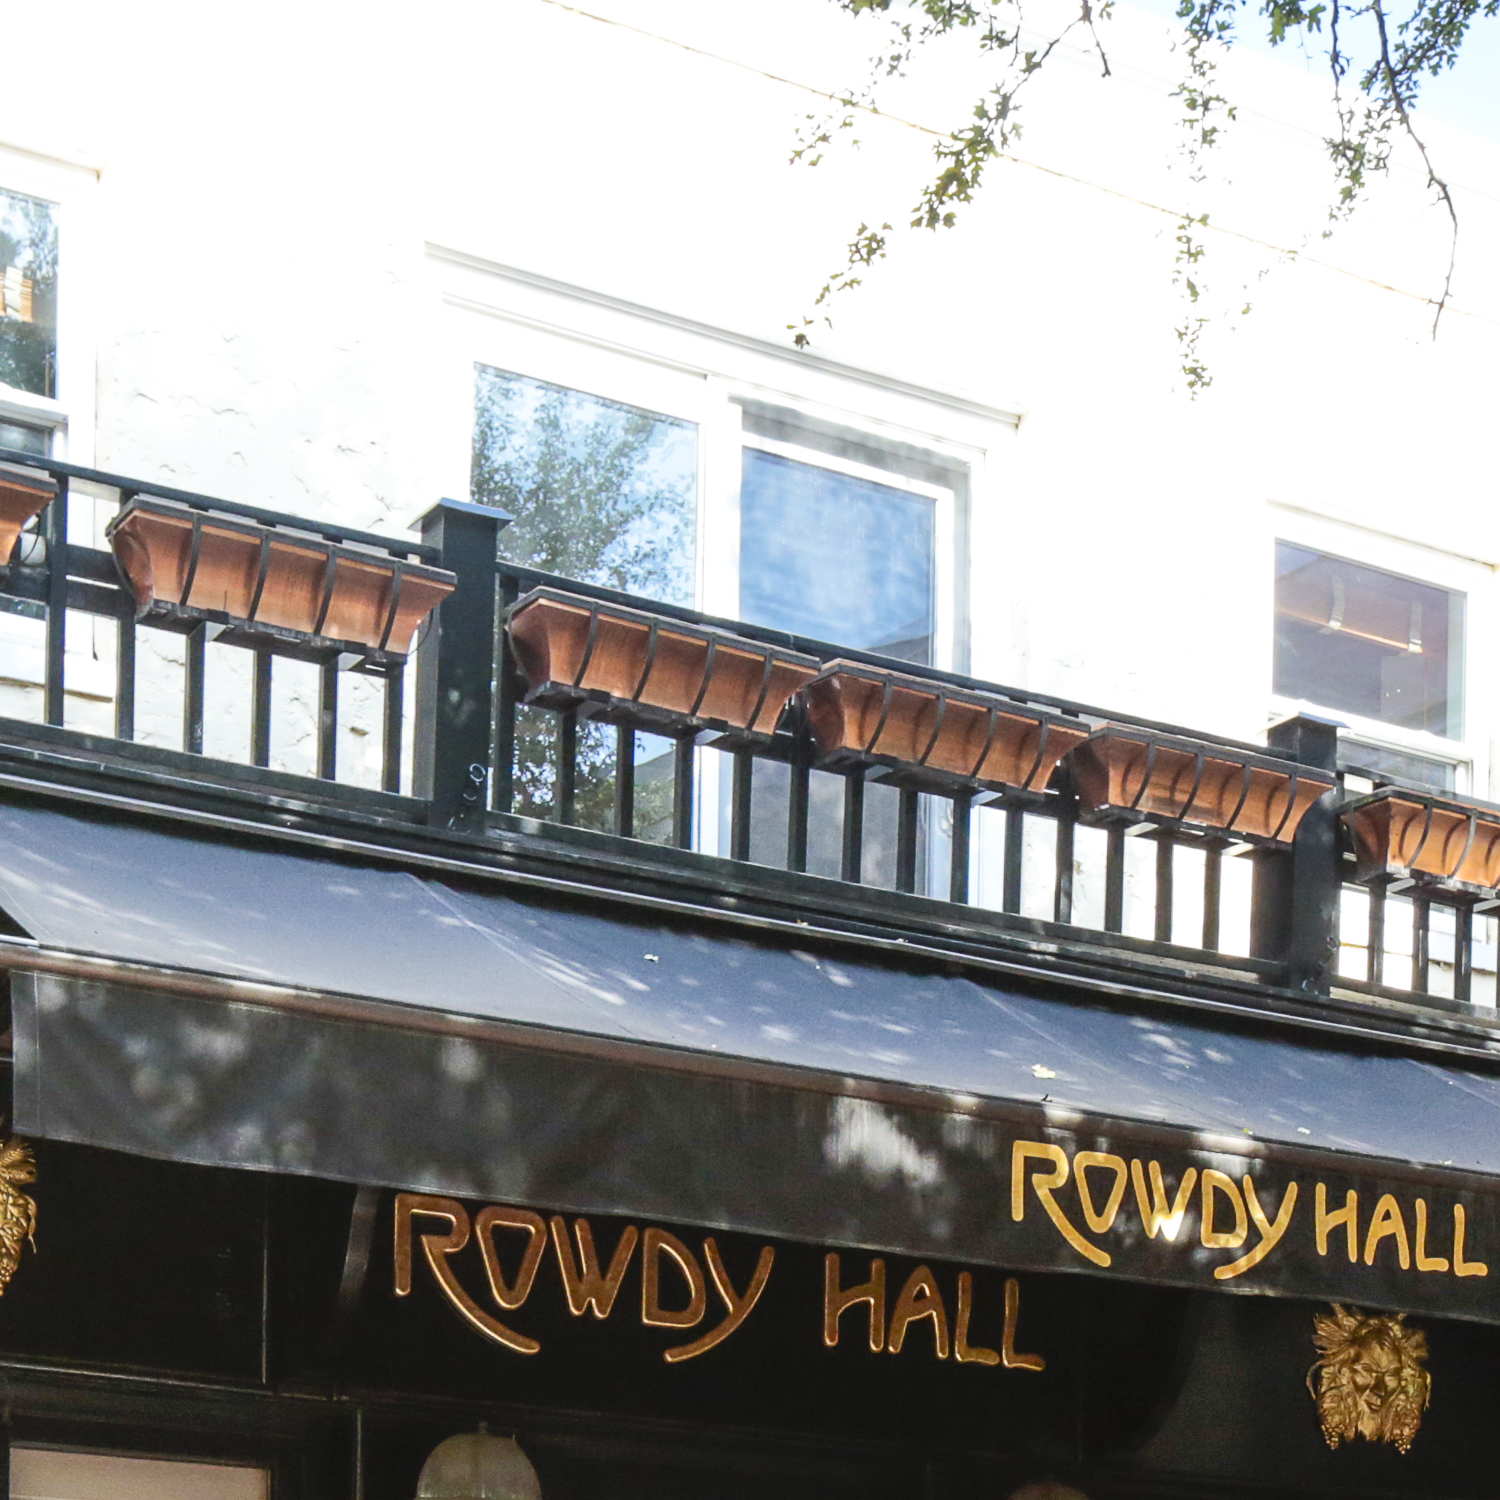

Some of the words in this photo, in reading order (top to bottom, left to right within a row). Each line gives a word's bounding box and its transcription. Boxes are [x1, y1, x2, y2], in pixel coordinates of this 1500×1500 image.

[394, 1194, 776, 1362] ROWDY
[824, 1253, 1045, 1371] HALL
[1011, 1139, 1298, 1280] ROWDY
[1315, 1181, 1489, 1277] HALL
